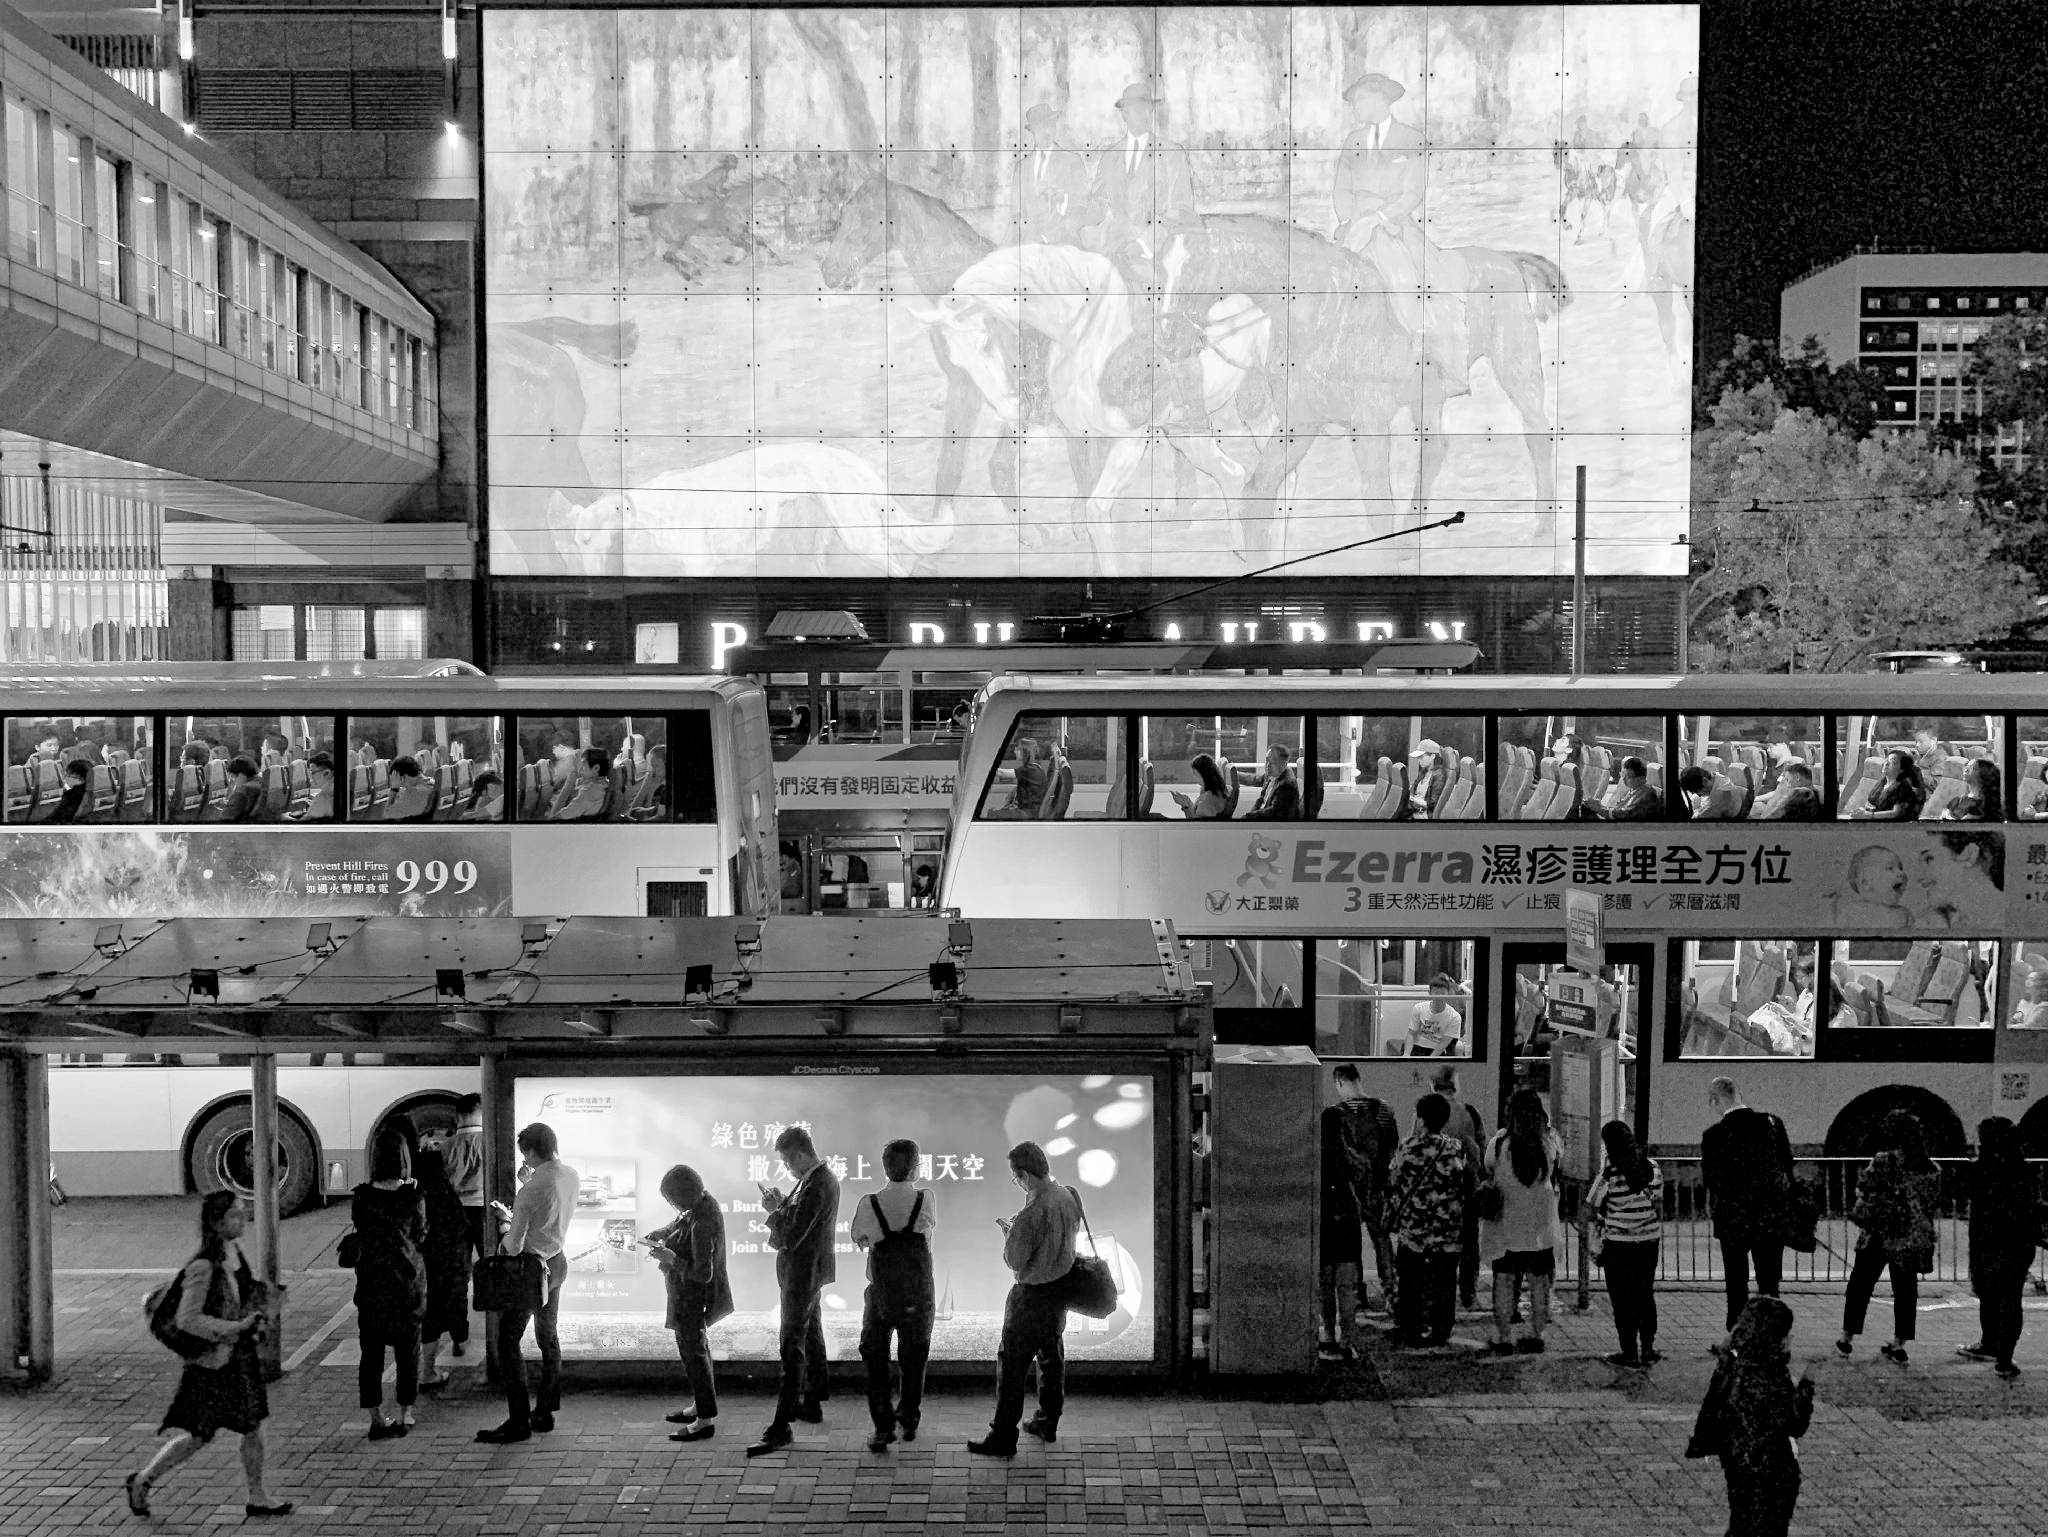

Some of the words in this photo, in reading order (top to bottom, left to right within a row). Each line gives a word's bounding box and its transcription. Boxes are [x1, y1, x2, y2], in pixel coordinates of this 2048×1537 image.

[1292, 841, 1474, 884] Ezerra
[1481, 843, 1793, 887] 濕疹護理全方位
[305, 861, 341, 871] Prevent
[343, 861, 362, 871] Hill
[364, 861, 389, 871] Fires
[396, 860, 478, 893] 999
[305, 872, 315, 881] In
[338, 872, 349, 881] of
[371, 872, 389, 881] call
[1668, 892, 1741, 911] 深層滋潤
[791, 1065, 838, 1074] JCDecaux
[731, 1240, 758, 1257] Join
